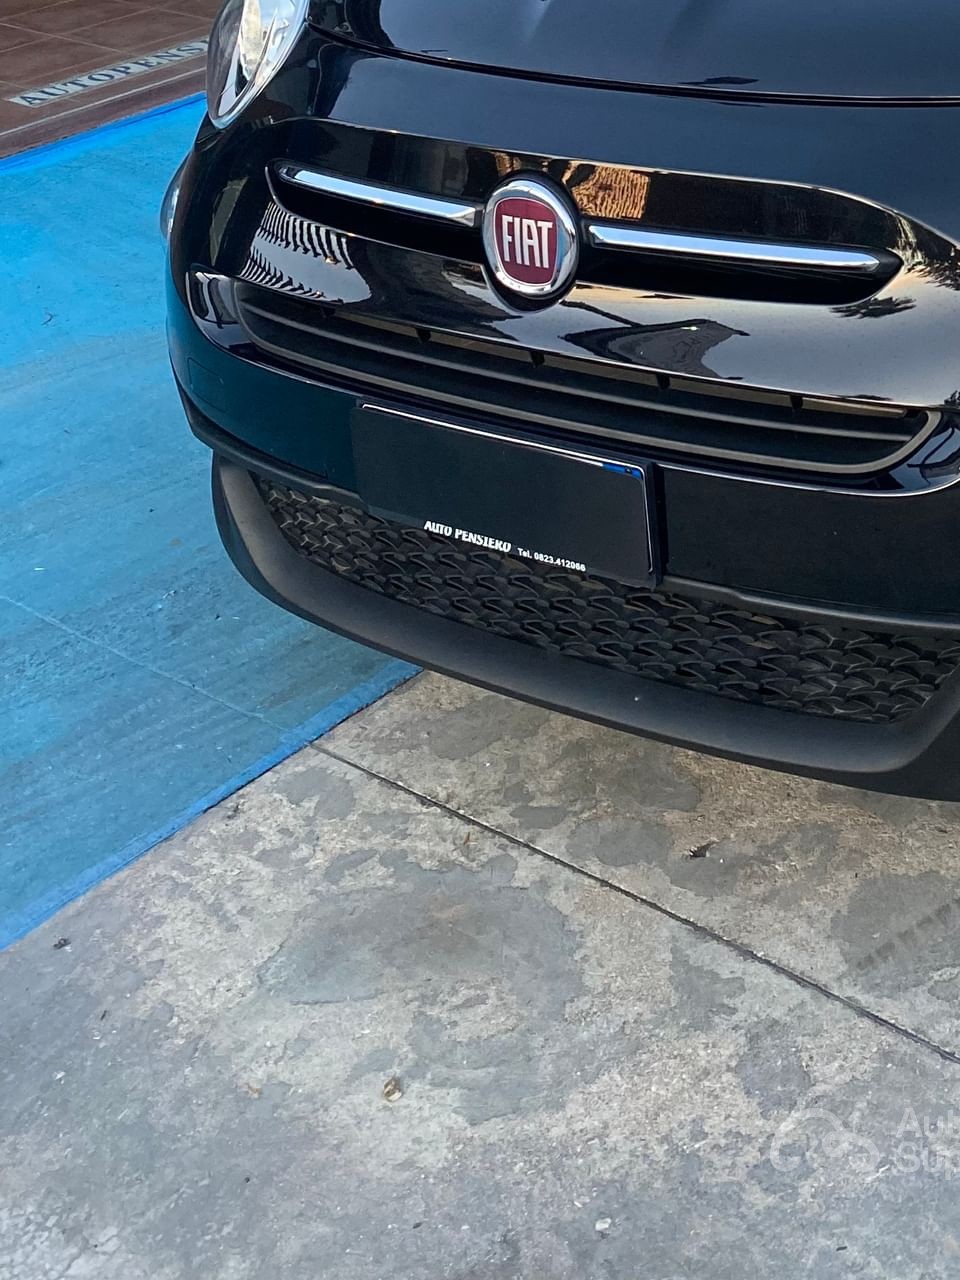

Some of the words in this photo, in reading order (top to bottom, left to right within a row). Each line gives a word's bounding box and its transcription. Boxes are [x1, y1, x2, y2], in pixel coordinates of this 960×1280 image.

[19, 39, 208, 106] AUTOPENS
[501, 214, 553, 269] FIAT
[423, 520, 453, 537] AUTO
[454, 528, 512, 553] PENSIERO
[516, 547, 533, 559] Tel.
